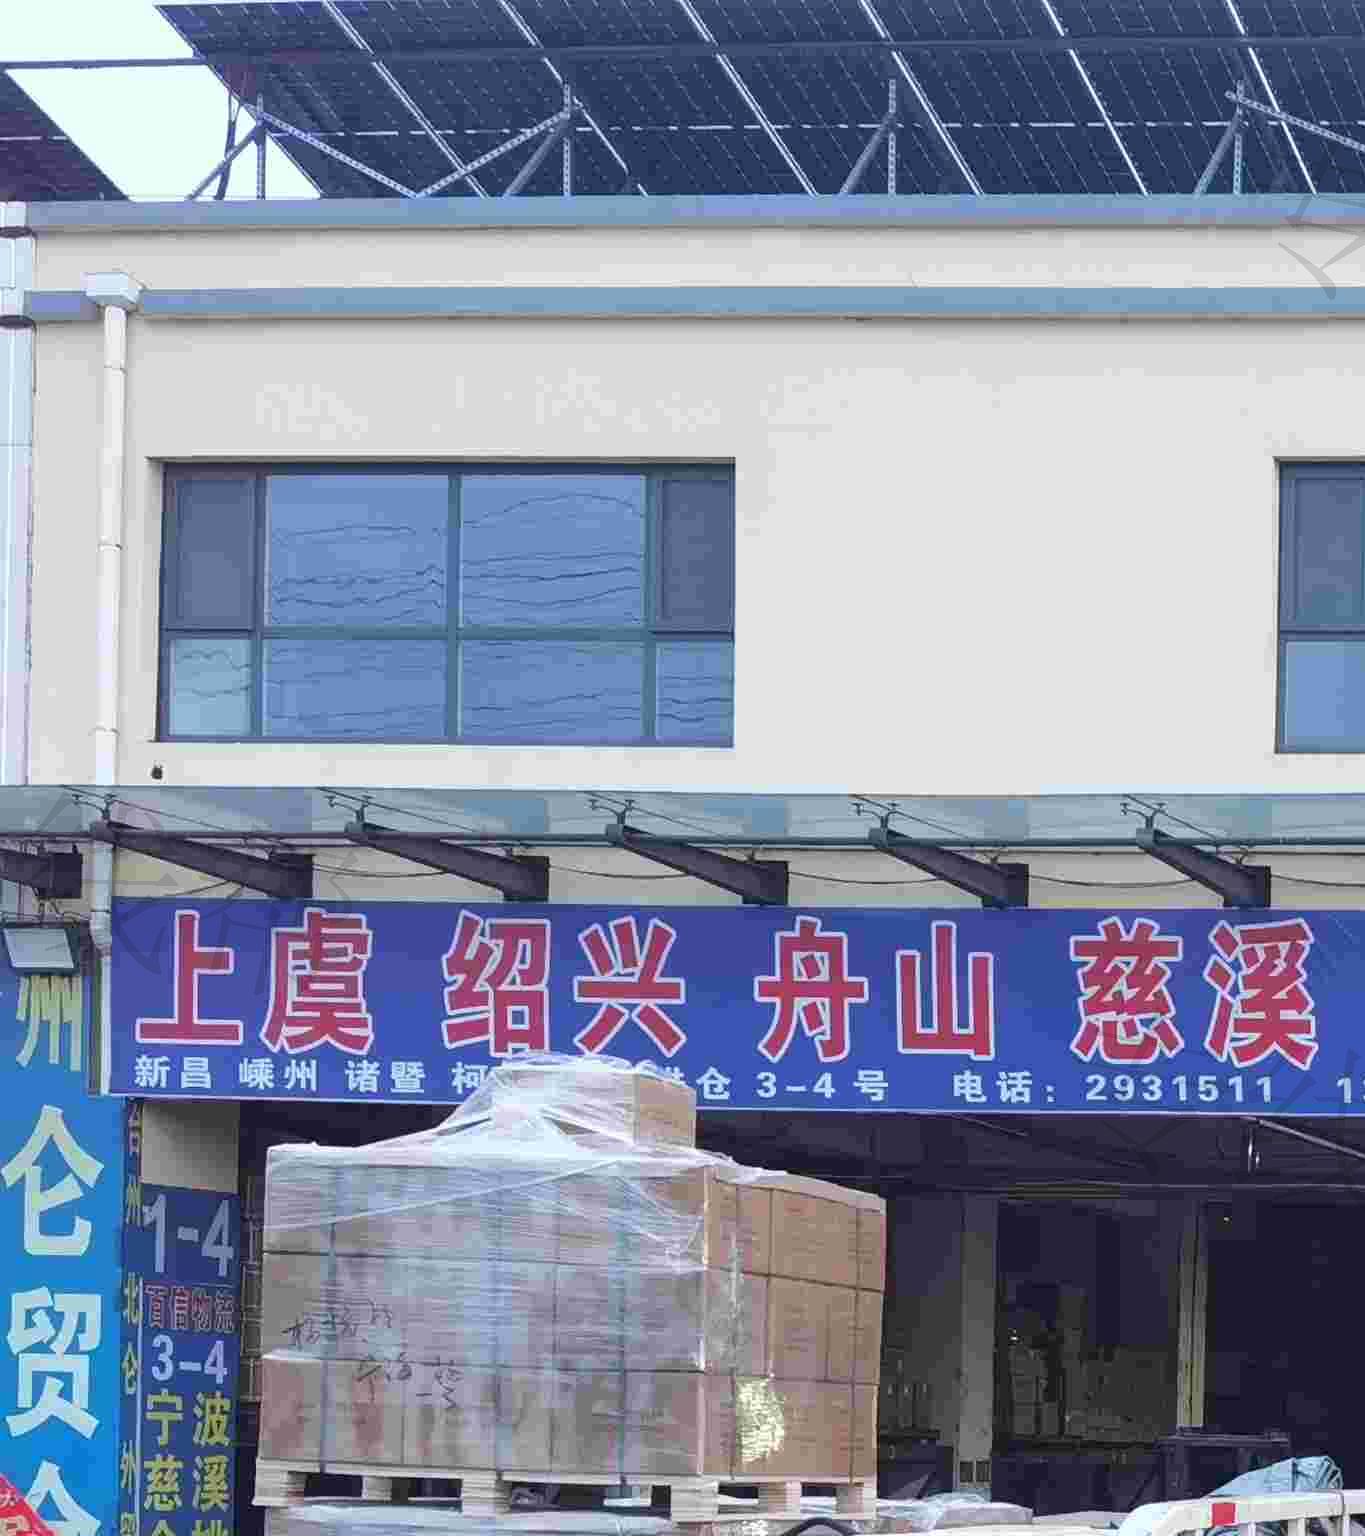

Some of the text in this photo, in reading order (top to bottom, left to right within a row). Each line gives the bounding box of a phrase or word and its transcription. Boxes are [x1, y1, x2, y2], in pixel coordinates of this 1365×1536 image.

[136, 908, 375, 1055] 上虞
[441, 909, 687, 1060] 绍兴
[754, 916, 995, 1063] 舟山
[1069, 916, 1320, 1070] 慈溪
[134, 1055, 214, 1090] 新昌
[239, 1058, 320, 1092] 嵊州
[346, 1061, 427, 1095] 诸暨
[1085, 1074, 1275, 1103] 2931511
[142, 1193, 235, 1278] 1-4
[150, 1333, 229, 1385] 3-4
[145, 1387, 231, 1448] 宁波
[143, 1453, 231, 1513] 慈溪
